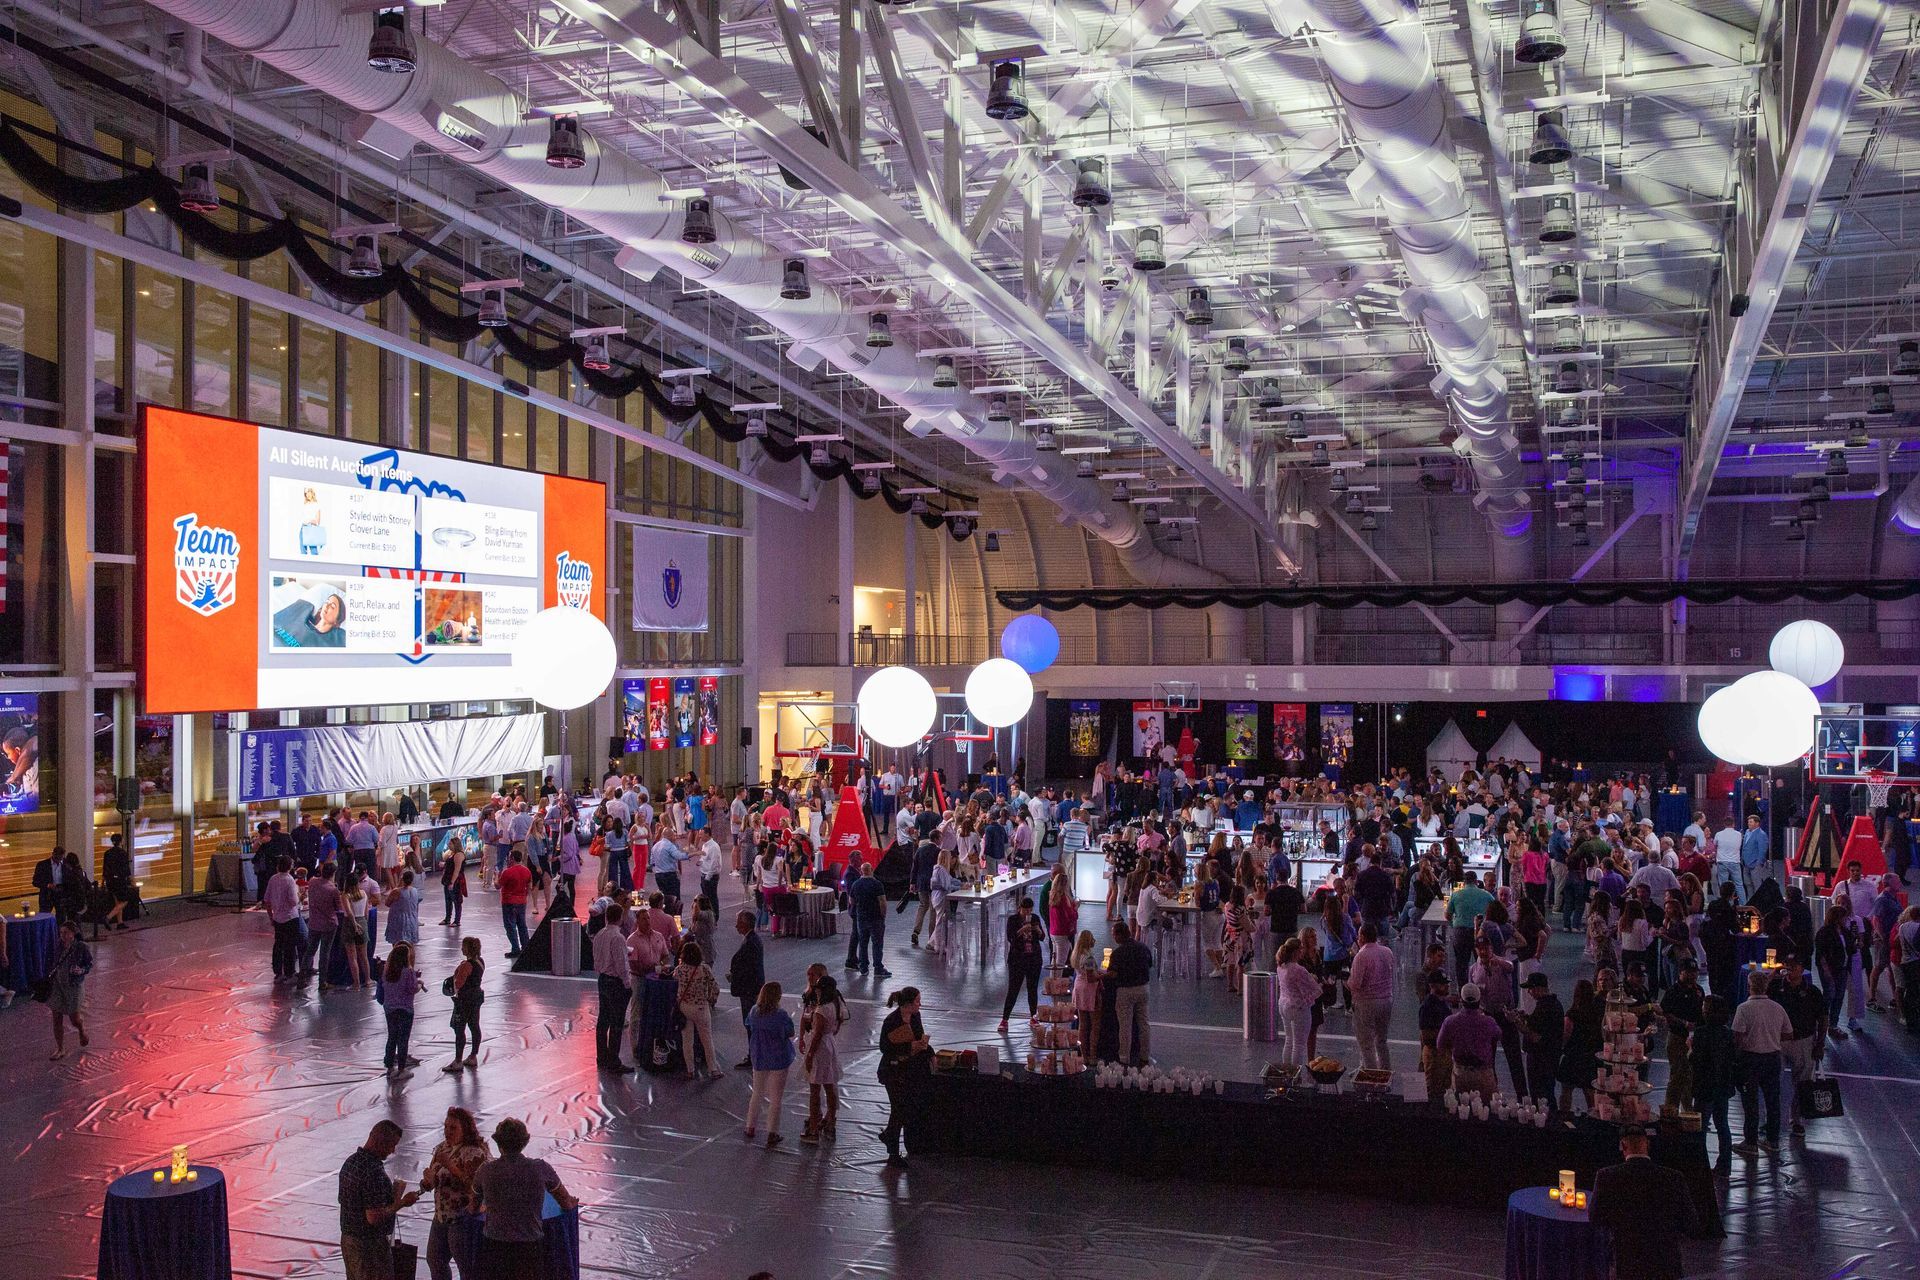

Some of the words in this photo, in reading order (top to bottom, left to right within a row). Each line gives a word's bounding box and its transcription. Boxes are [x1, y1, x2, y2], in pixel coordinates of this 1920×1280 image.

[270, 447, 288, 464] All
[291, 449, 329, 470] Silent
[331, 456, 380, 477] Auction
[381, 463, 413, 482] Items
[349, 510, 371, 521] Styled
[373, 512, 387, 522] with
[388, 513, 411, 526] Stoney
[176, 516, 238, 556] Team
[349, 522, 372, 535] Clover
[373, 525, 390, 536] Lane
[177, 555, 237, 570] IMPACT
[557, 553, 591, 581] Team
[558, 582, 591, 592] IMPACT
[349, 598, 366, 609] Run,
[387, 600, 401, 610] and
[349, 611, 381, 622] Recover!
[1730, 647, 1741, 658] 15
